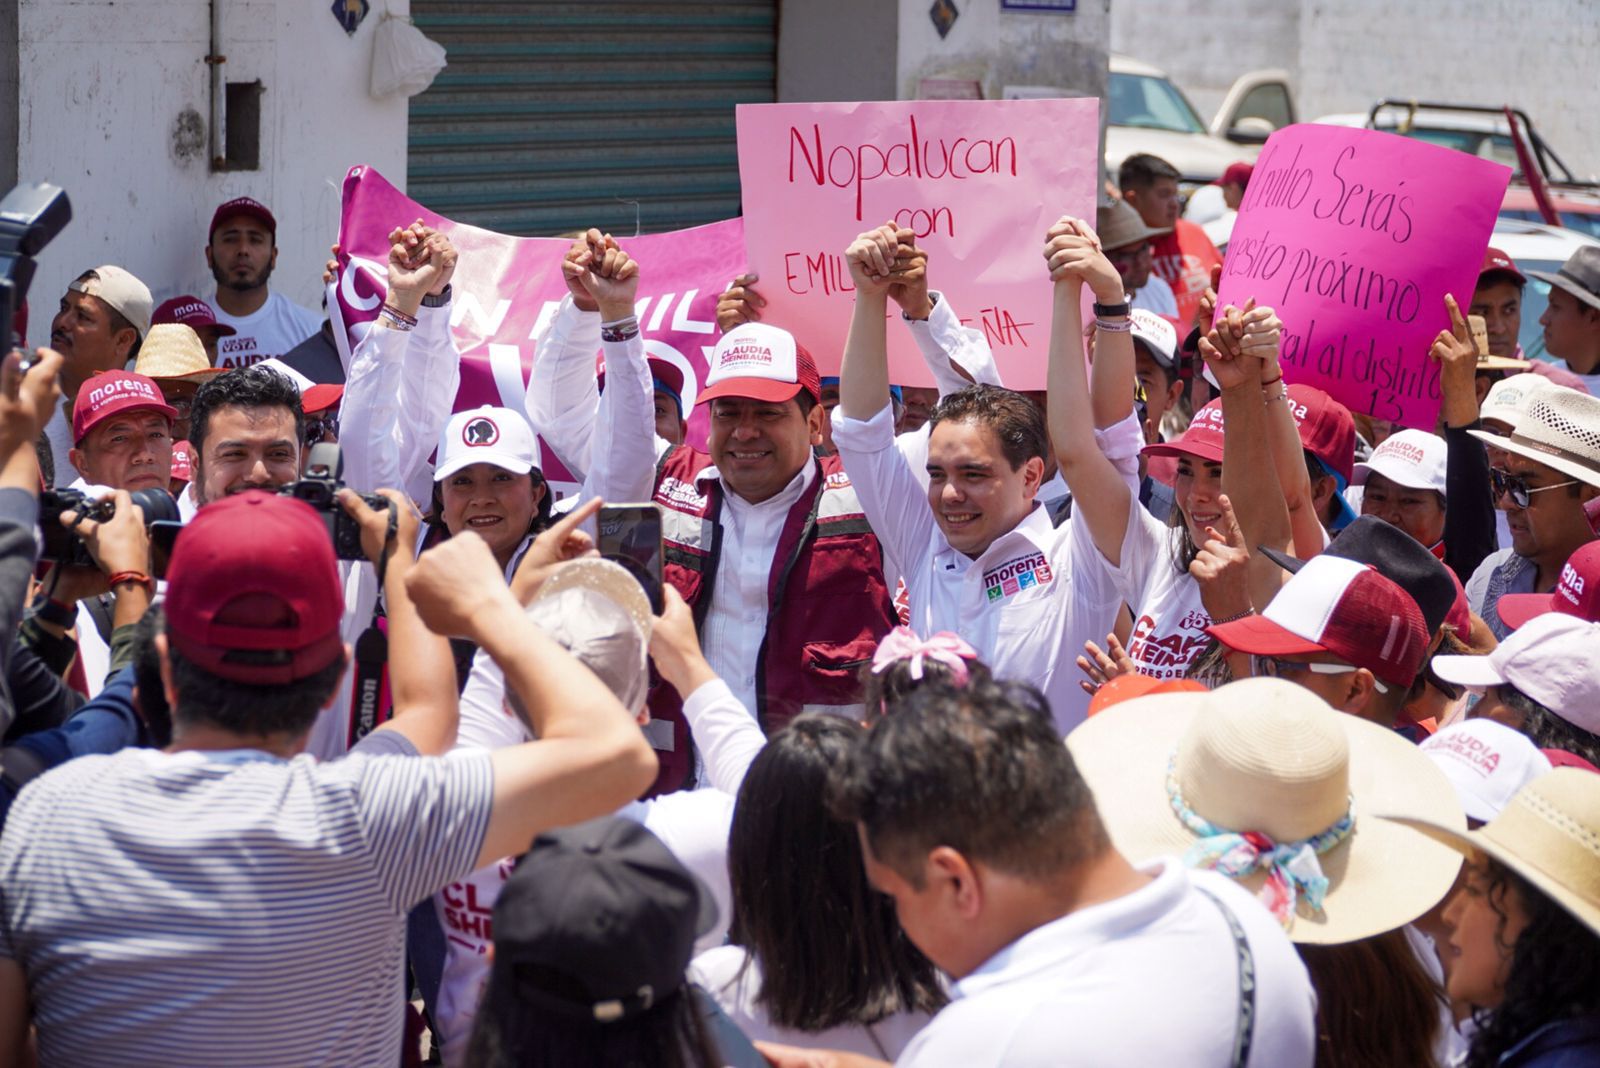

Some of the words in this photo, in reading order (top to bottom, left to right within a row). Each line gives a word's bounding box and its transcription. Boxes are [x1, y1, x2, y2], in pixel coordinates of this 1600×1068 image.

[788, 113, 1017, 221] Nopalucan
[1313, 146, 1414, 244] Serás
[341, 254, 513, 336] CN
[785, 251, 857, 296] EMIL
[1283, 248, 1421, 324] próximo
[721, 345, 772, 360] CLAUDIA
[1318, 334, 1347, 379] al
[89, 379, 155, 404] morena
[984, 555, 1048, 589] morena
